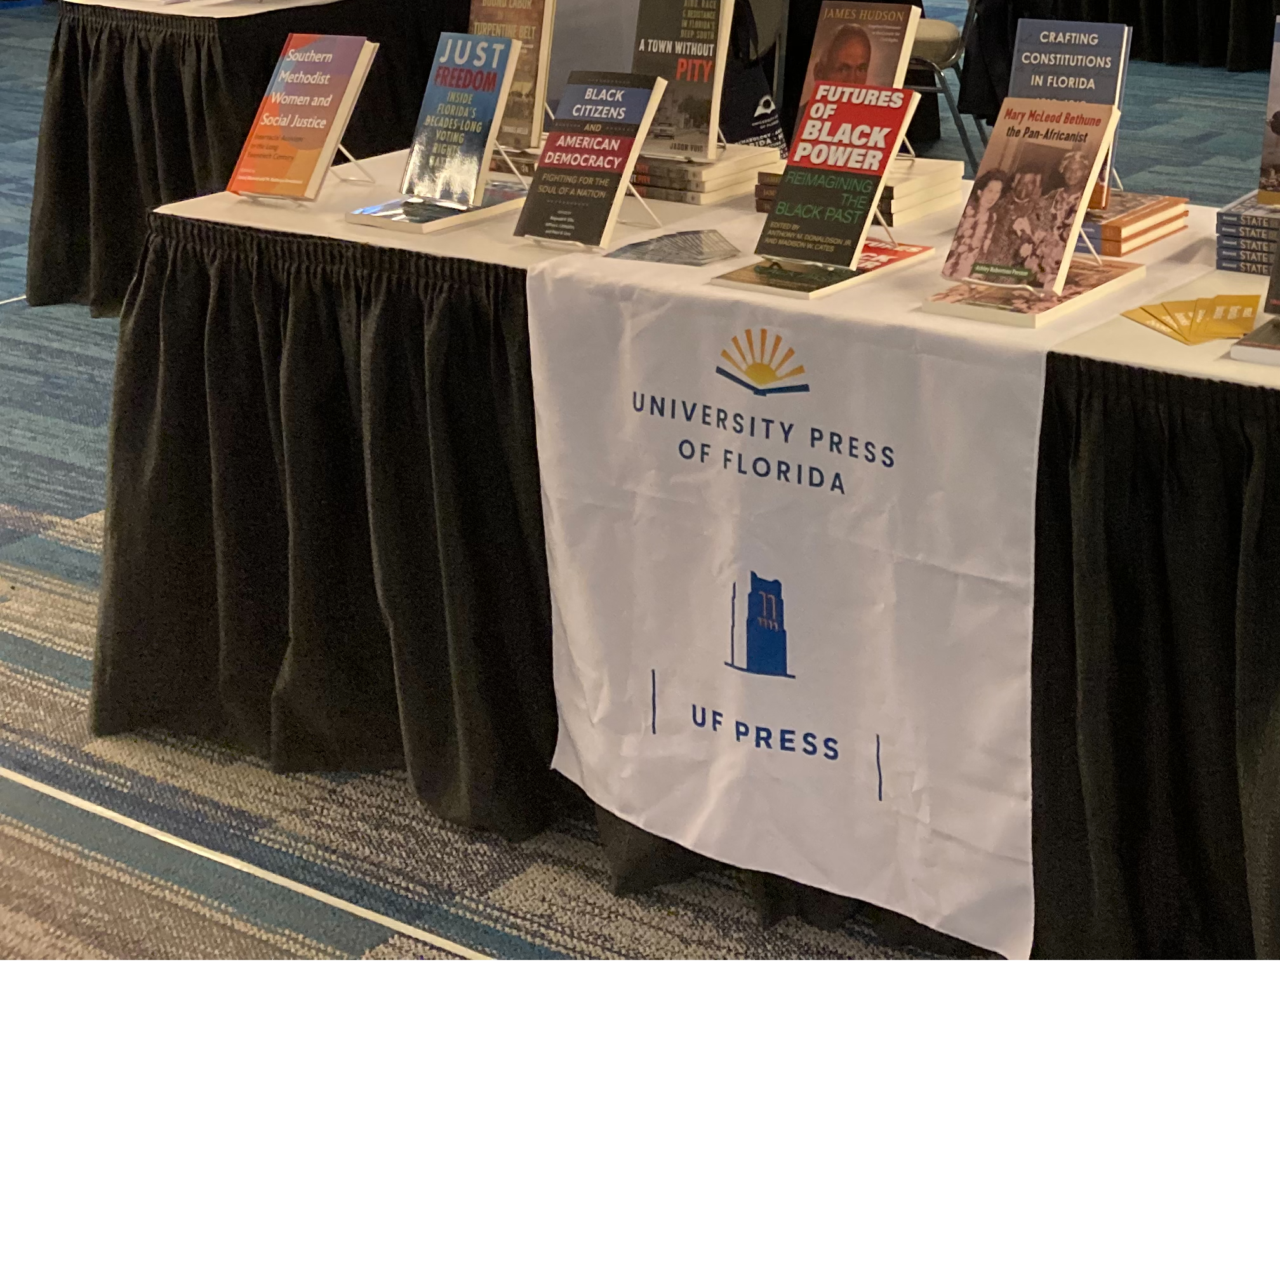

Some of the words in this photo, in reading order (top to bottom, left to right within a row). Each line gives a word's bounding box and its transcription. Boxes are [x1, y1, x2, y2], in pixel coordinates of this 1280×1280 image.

[824, 8, 857, 20] JAMES
[859, 10, 904, 21] HUDSON
[474, 22, 517, 38] TURPENTINE
[519, 26, 536, 40] BELT
[1039, 31, 1099, 45] CRAFTING
[439, 39, 505, 69] JUST
[639, 39, 645, 51] A
[647, 39, 673, 53] TOWN
[675, 41, 714, 56] WITHOUT
[286, 49, 333, 63] Southern
[1021, 51, 1112, 69] CONSTITUTIONS
[277, 70, 330, 85] Methodist
[675, 57, 713, 82] PITY
[433, 65, 497, 93] FREEDOM
[1030, 75, 1044, 87] IN
[1047, 75, 1096, 91] FLORIDA
[271, 92, 310, 106] Women
[311, 94, 332, 107] and
[447, 91, 474, 104] INSIDE
[584, 87, 623, 102] BLACK
[815, 85, 904, 109] FUTURES
[437, 103, 477, 119] FLORIDA'S
[572, 104, 626, 120] CITIZENS
[809, 102, 837, 119] OF
[1004, 107, 1027, 125] Mary
[1028, 109, 1061, 125] McLeod
[1063, 112, 1101, 127] Bethune
[260, 113, 291, 127] Social
[291, 113, 327, 129] Justice
[424, 115, 482, 133] DECADES-LONG
[584, 123, 602, 132] AND
[436, 129, 465, 144] VOTING
[801, 120, 892, 149] BLACK
[1006, 126, 1021, 138] the
[1022, 126, 1088, 144] Pan-Africanist
[555, 135, 620, 151] AMERICAN
[544, 152, 622, 169] DEMOCRACY
[793, 142, 886, 171] POWER
[541, 173, 577, 184] FIGHTING
[578, 175, 595, 185] FOR
[595, 177, 610, 187] THE
[785, 170, 873, 193] REIMAGINING
[537, 185, 556, 195] SOUL
[557, 187, 569, 196] OF
[569, 188, 577, 196] A
[576, 188, 606, 199] NATION
[841, 193, 869, 209] THE
[775, 201, 823, 219] BLACK
[824, 207, 864, 224] PAST
[1240, 215, 1269, 226] STATE
[1239, 228, 1268, 238] STATE
[1239, 240, 1269, 251] STATE
[1239, 251, 1268, 262] STATE
[1240, 263, 1268, 274] STATE
[632, 391, 794, 444] UNIVERSITY
[810, 427, 895, 468] PRESS
[678, 439, 711, 463] OF
[723, 449, 845, 495] FLORIDA
[691, 703, 723, 732] UF
[734, 720, 839, 761] PRESS
